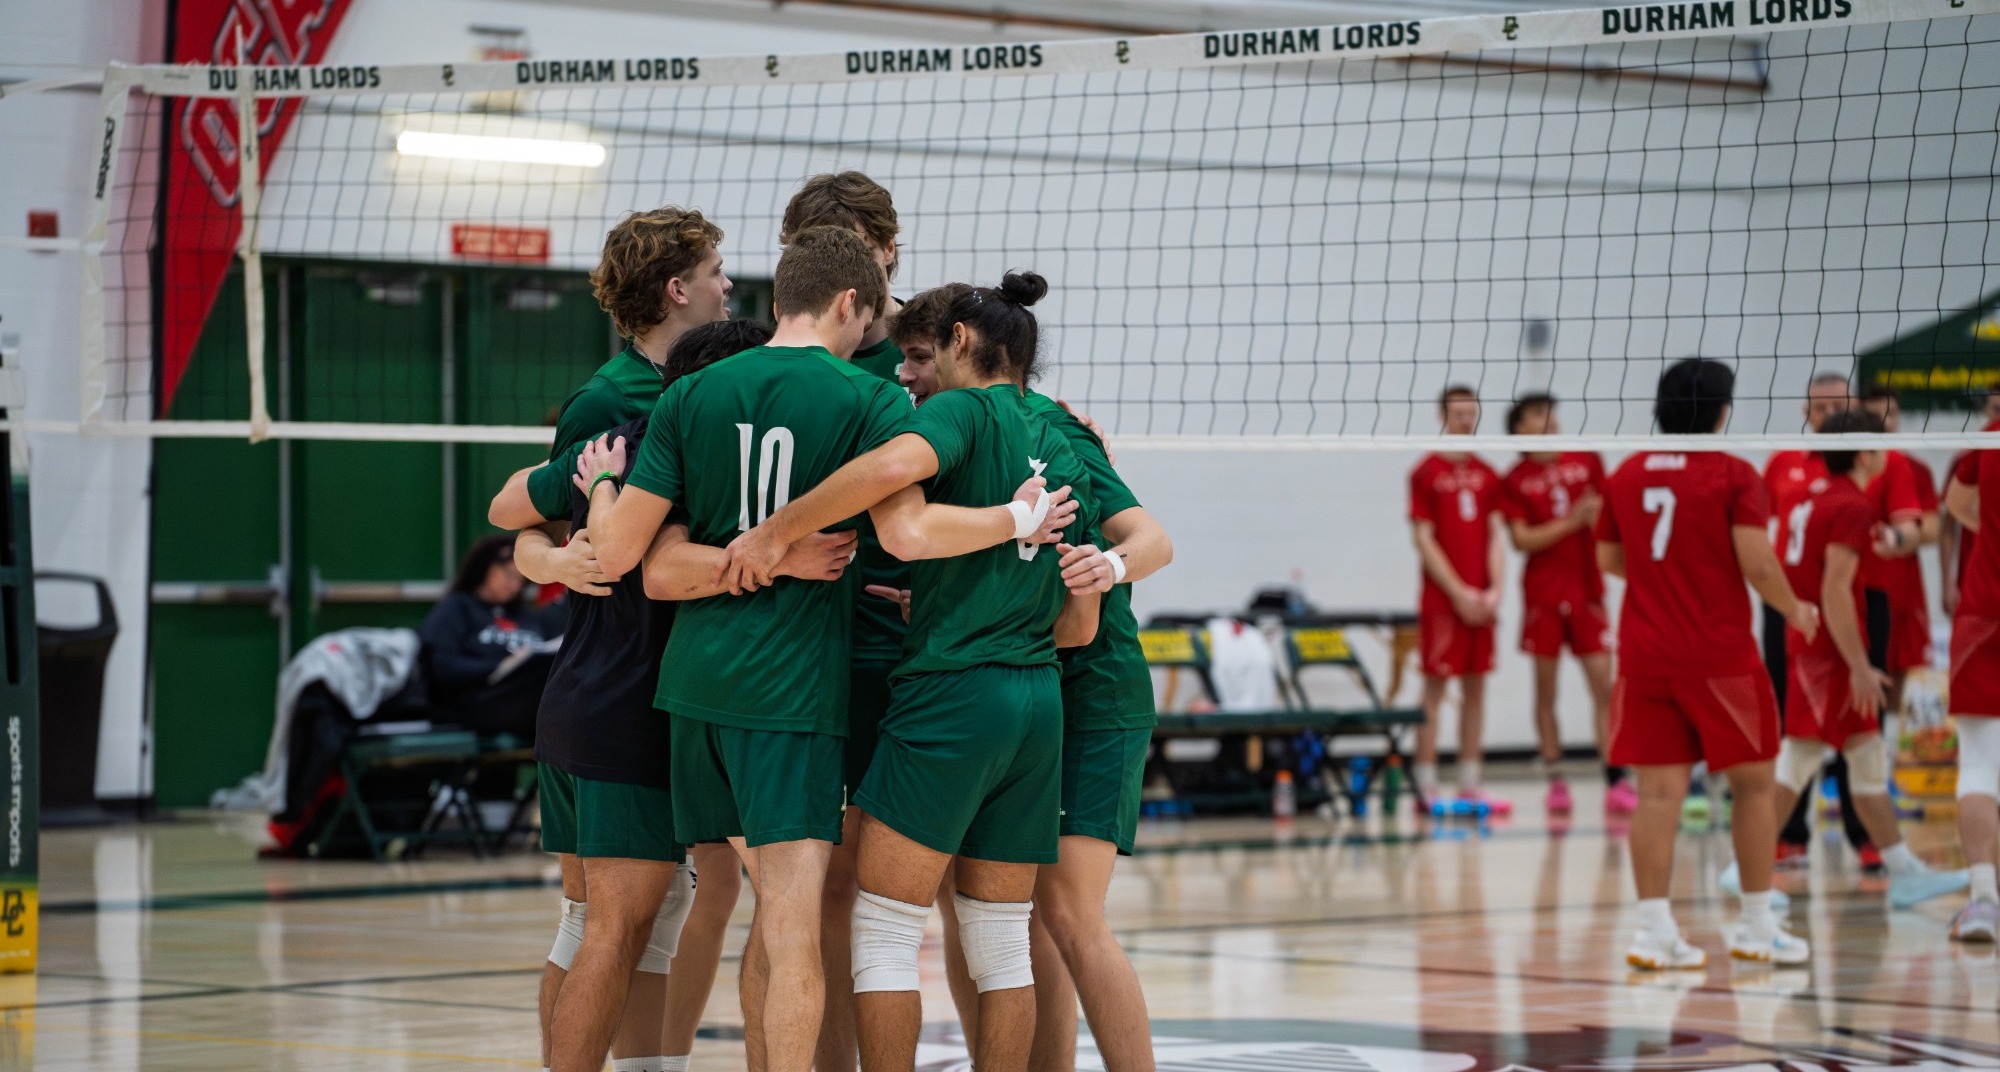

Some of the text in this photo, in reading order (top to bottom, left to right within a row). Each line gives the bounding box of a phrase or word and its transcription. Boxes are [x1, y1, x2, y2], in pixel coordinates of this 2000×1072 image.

[1602, 0, 1852, 36] DURHAM LORDS
[1204, 21, 1421, 59] DURHAM LORDS
[516, 57, 700, 85] DURHAM LORDS
[846, 44, 1043, 75] DURHAM LORDS
[208, 66, 381, 92] DUHAM LORDS
[735, 423, 794, 531] 10
[1642, 486, 1677, 561] 7
[7, 716, 22, 867] sports imports
